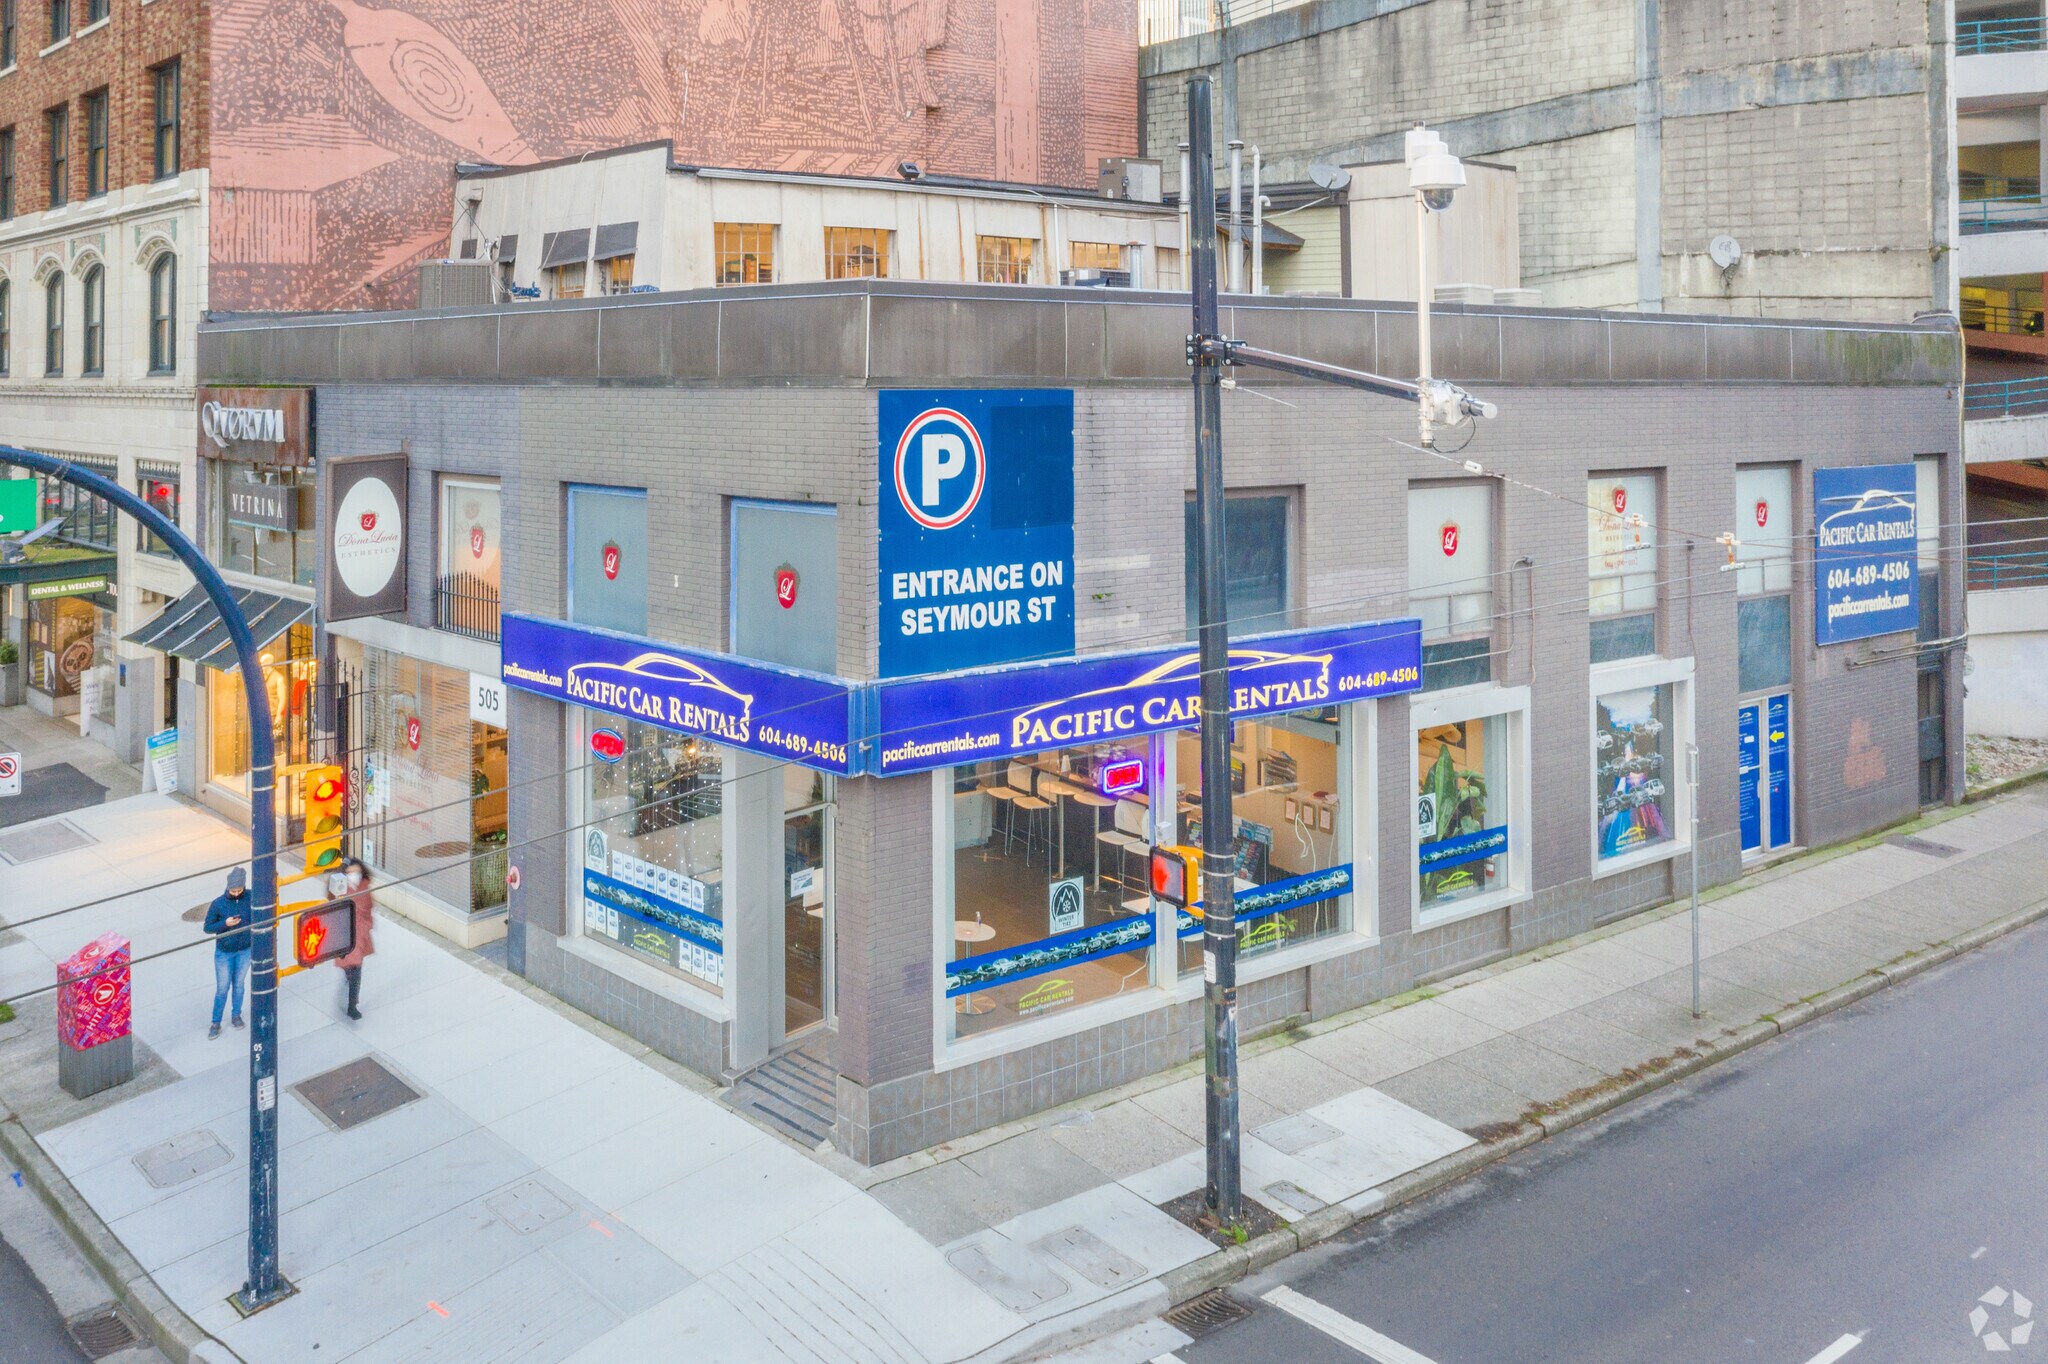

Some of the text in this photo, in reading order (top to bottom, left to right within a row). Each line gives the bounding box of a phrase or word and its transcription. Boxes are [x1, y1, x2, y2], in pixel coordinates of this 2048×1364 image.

[922, 433, 966, 507] P
[232, 493, 283, 519] VETRINA
[1819, 518, 1915, 547] PACIFIC CAR RENTALS
[341, 547, 396, 558] ESTHETICS
[31, 586, 59, 596] DENTAL
[60, 584, 67, 592] &
[67, 580, 104, 591] WELLNESS
[892, 560, 1063, 600] ENTRANCE ON
[1827, 561, 1910, 590] 604-689-4506
[900, 595, 1056, 636] SEYMOUR ST
[1828, 590, 1910, 624] pacificcarrentals.com
[503, 662, 563, 688] pacificcarrentals.com
[1338, 667, 1419, 692] 604-689-4506
[478, 686, 499, 711] 505
[566, 668, 750, 743] PACIFIC CAR RENTALS
[1010, 674, 1329, 748] PACIFIC CAR ENTALS
[758, 725, 847, 764] 604-689-4506
[882, 732, 1000, 768] pacificcarrentals.com
[1058, 914, 1075, 924] WINTER
